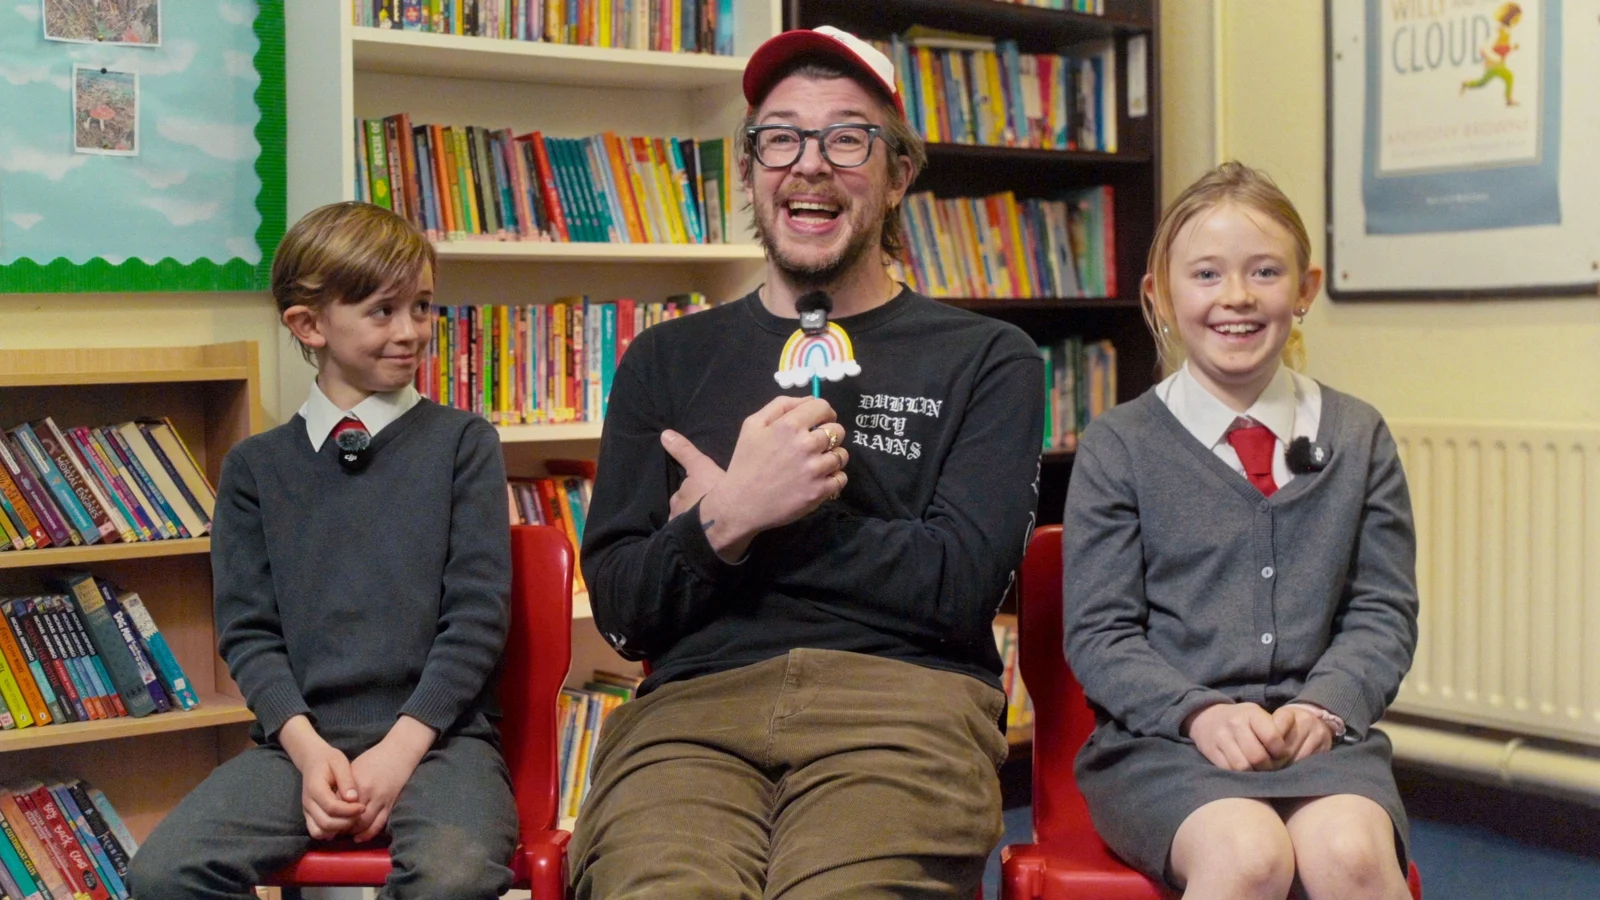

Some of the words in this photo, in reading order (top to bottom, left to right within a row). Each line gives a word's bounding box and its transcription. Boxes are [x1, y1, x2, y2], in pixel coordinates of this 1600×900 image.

[1392, 15, 1490, 75] CLOUD
[855, 414, 907, 437] CITY
[858, 394, 943, 418] DUBLIN
[852, 430, 922, 461] RAINS
[54, 454, 79, 488] MORTAL
[74, 486, 99, 520] ENGINES
[9, 616, 23, 636] MICHAEL
[18, 635, 35, 662] MORPURGO
[32, 614, 46, 635] MICHAEL
[41, 634, 58, 659] MORPURGO
[42, 613, 56, 634] MICHAEL
[52, 633, 68, 659] MORPURGO
[51, 612, 64, 633] MICHAEL
[60, 632, 76, 657] MORPURGO
[60, 611, 74, 632] MICHAEL
[70, 631, 86, 656] MORPURGO
[70, 611, 83, 631] MICHAEL
[80, 630, 96, 656] MORPURGO
[111, 610, 128, 629] DOG
[119, 625, 135, 643] MAN
[22, 618, 40, 646] ACROSS
[35, 646, 48, 663] THE
[42, 661, 60, 688] DIVIDE
[4, 826, 28, 860] CUT-THROAT
[23, 858, 37, 876] CELTS
